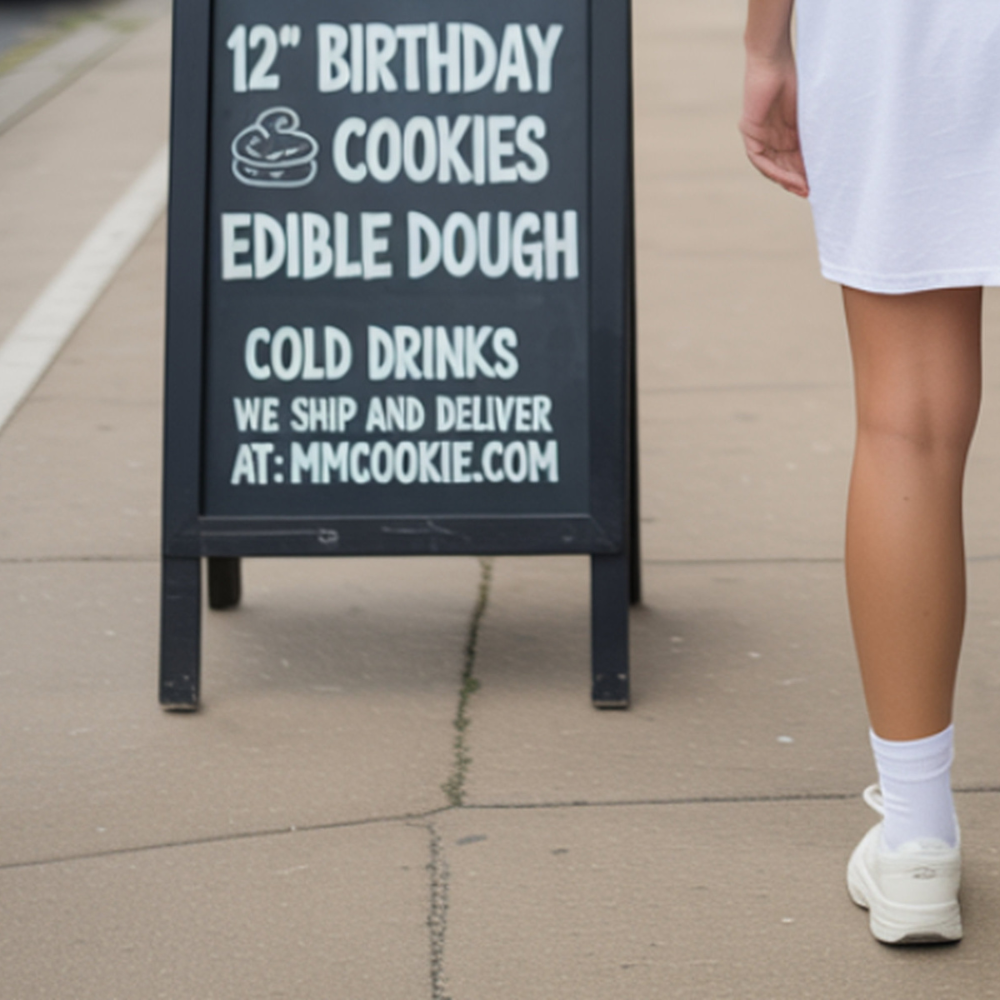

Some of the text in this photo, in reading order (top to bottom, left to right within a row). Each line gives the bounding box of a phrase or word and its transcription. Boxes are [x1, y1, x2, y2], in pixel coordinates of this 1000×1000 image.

[227, 22, 563, 94] 12" BIRTHDAY
[333, 114, 549, 185] COOKIES
[222, 210, 578, 281] EDIBLE DOUGH
[245, 325, 518, 380] COLD DRINKS
[234, 395, 552, 432] WE SHIP AND DELIVER
[231, 440, 558, 484] AT: MMCOOKIE.COM
